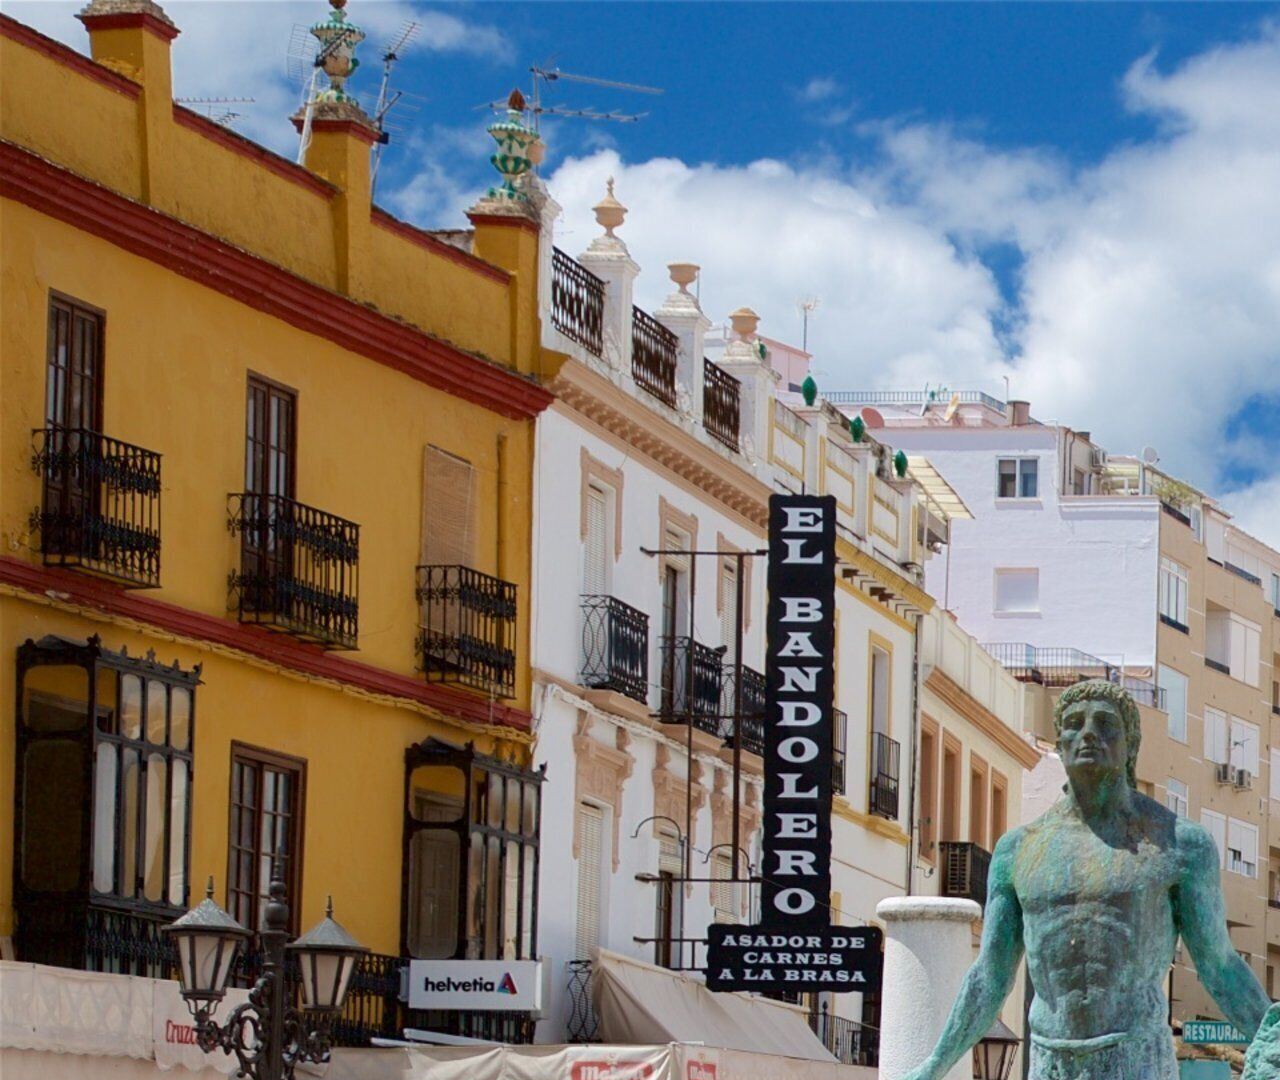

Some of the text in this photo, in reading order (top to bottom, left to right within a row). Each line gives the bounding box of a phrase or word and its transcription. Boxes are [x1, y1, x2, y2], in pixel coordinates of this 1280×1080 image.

[779, 506, 824, 565] EL
[773, 596, 824, 915] BANDOLERO
[721, 934, 866, 949] ASADOR DE
[743, 952, 844, 965] CARNES
[717, 968, 867, 983] A LA BRASA
[424, 976, 495, 992] helvetia
